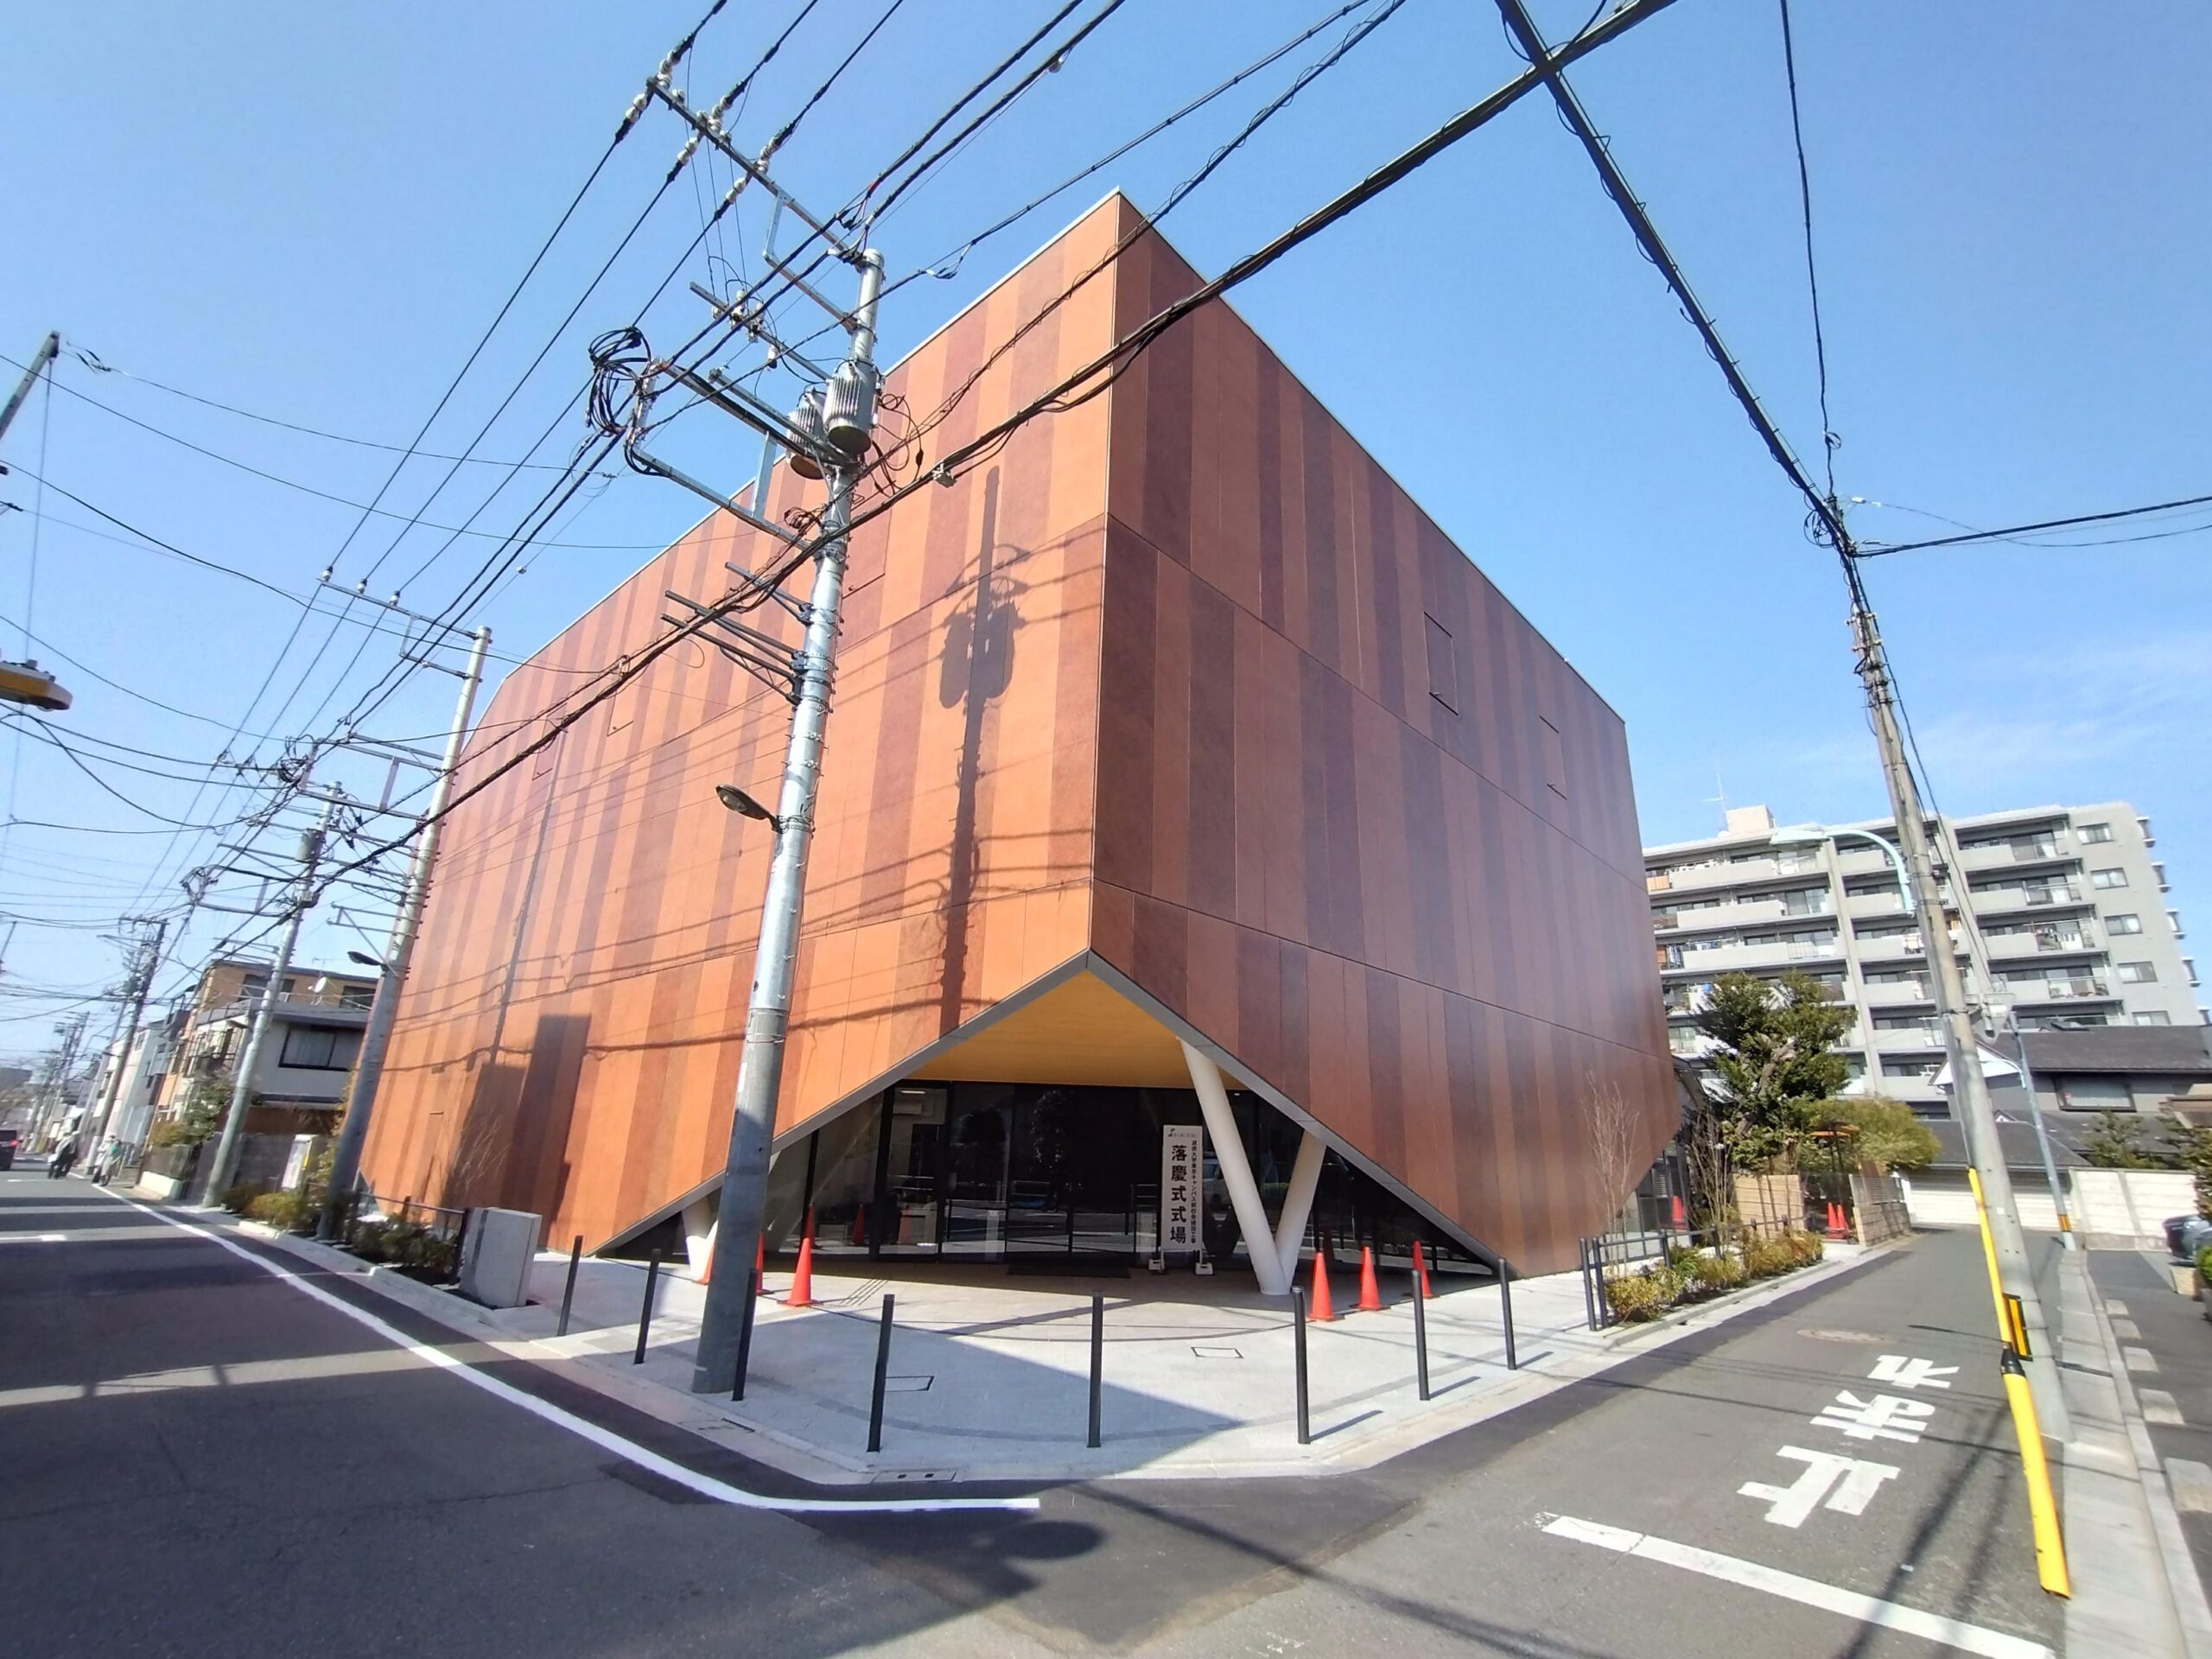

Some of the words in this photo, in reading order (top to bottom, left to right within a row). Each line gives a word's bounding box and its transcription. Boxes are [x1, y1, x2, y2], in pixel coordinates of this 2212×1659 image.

[1170, 1145, 1187, 1244] 落慶式式場
[1737, 1355, 1960, 1529] 止まれ
